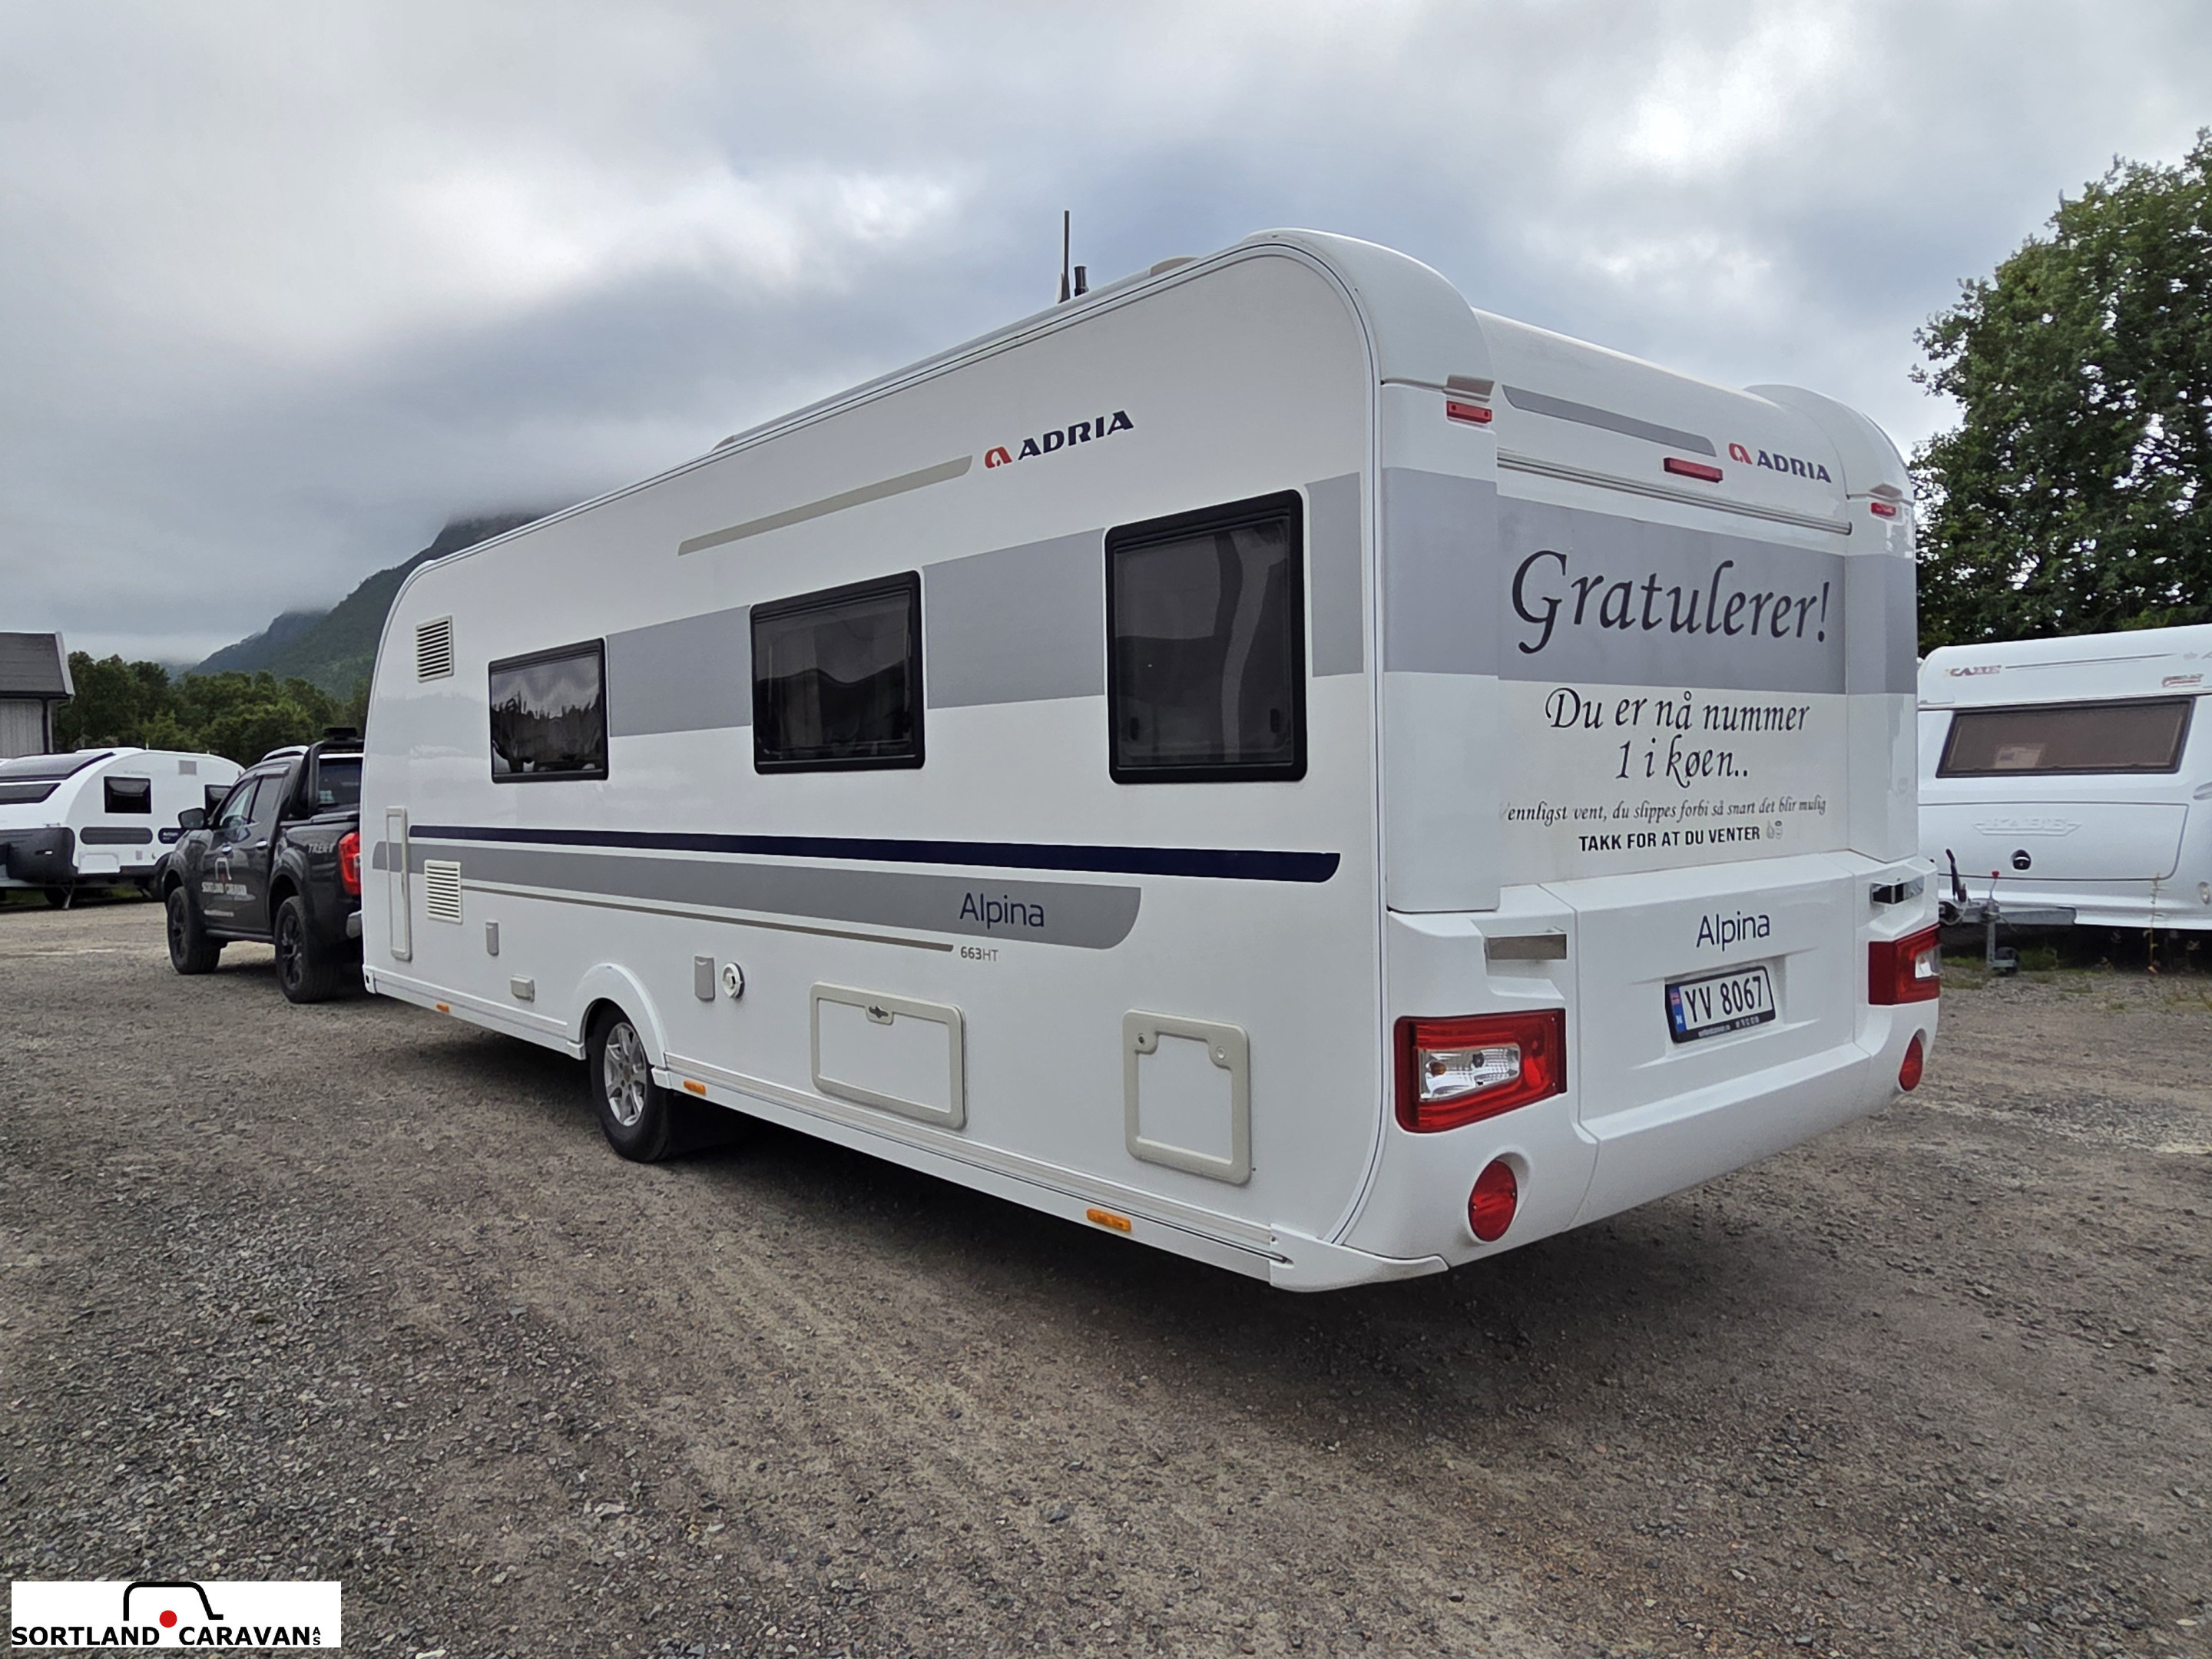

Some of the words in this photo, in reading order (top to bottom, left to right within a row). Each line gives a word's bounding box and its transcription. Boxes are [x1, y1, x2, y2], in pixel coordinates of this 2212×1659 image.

[1018, 410, 1134, 460] ADRIA
[1757, 449, 1832, 483] ADRIA
[1512, 549, 1830, 654] Gratulerer!
[1545, 687, 1603, 729] Du
[1615, 697, 1647, 726] er
[1655, 690, 1692, 730] nå
[1703, 704, 1810, 731] nummer
[1615, 740, 1631, 779] 1
[1644, 737, 1656, 777] i
[1666, 734, 1748, 788] køen..
[1501, 800, 1568, 827] ennligst
[1572, 806, 1607, 822] vent,
[1612, 800, 1629, 819] du
[1633, 800, 1676, 823] slippes
[1676, 799, 1710, 823] forbi
[1711, 800, 1724, 816] så
[1727, 802, 1755, 815] snart
[1759, 796, 1775, 813] det
[1778, 796, 1797, 813] blir
[1578, 834, 1621, 851] TAKK
[1627, 833, 1656, 849] FOR
[1661, 831, 1681, 846] AT
[1685, 830, 1704, 846] DU
[1708, 826, 1760, 843] VENTER
[960, 892, 1045, 929] Alpina
[1696, 911, 1770, 952] Alpina
[960, 945, 998, 962] 663HT
[1684, 985, 1711, 1022] YV
[1720, 975, 1761, 1015] 8067
